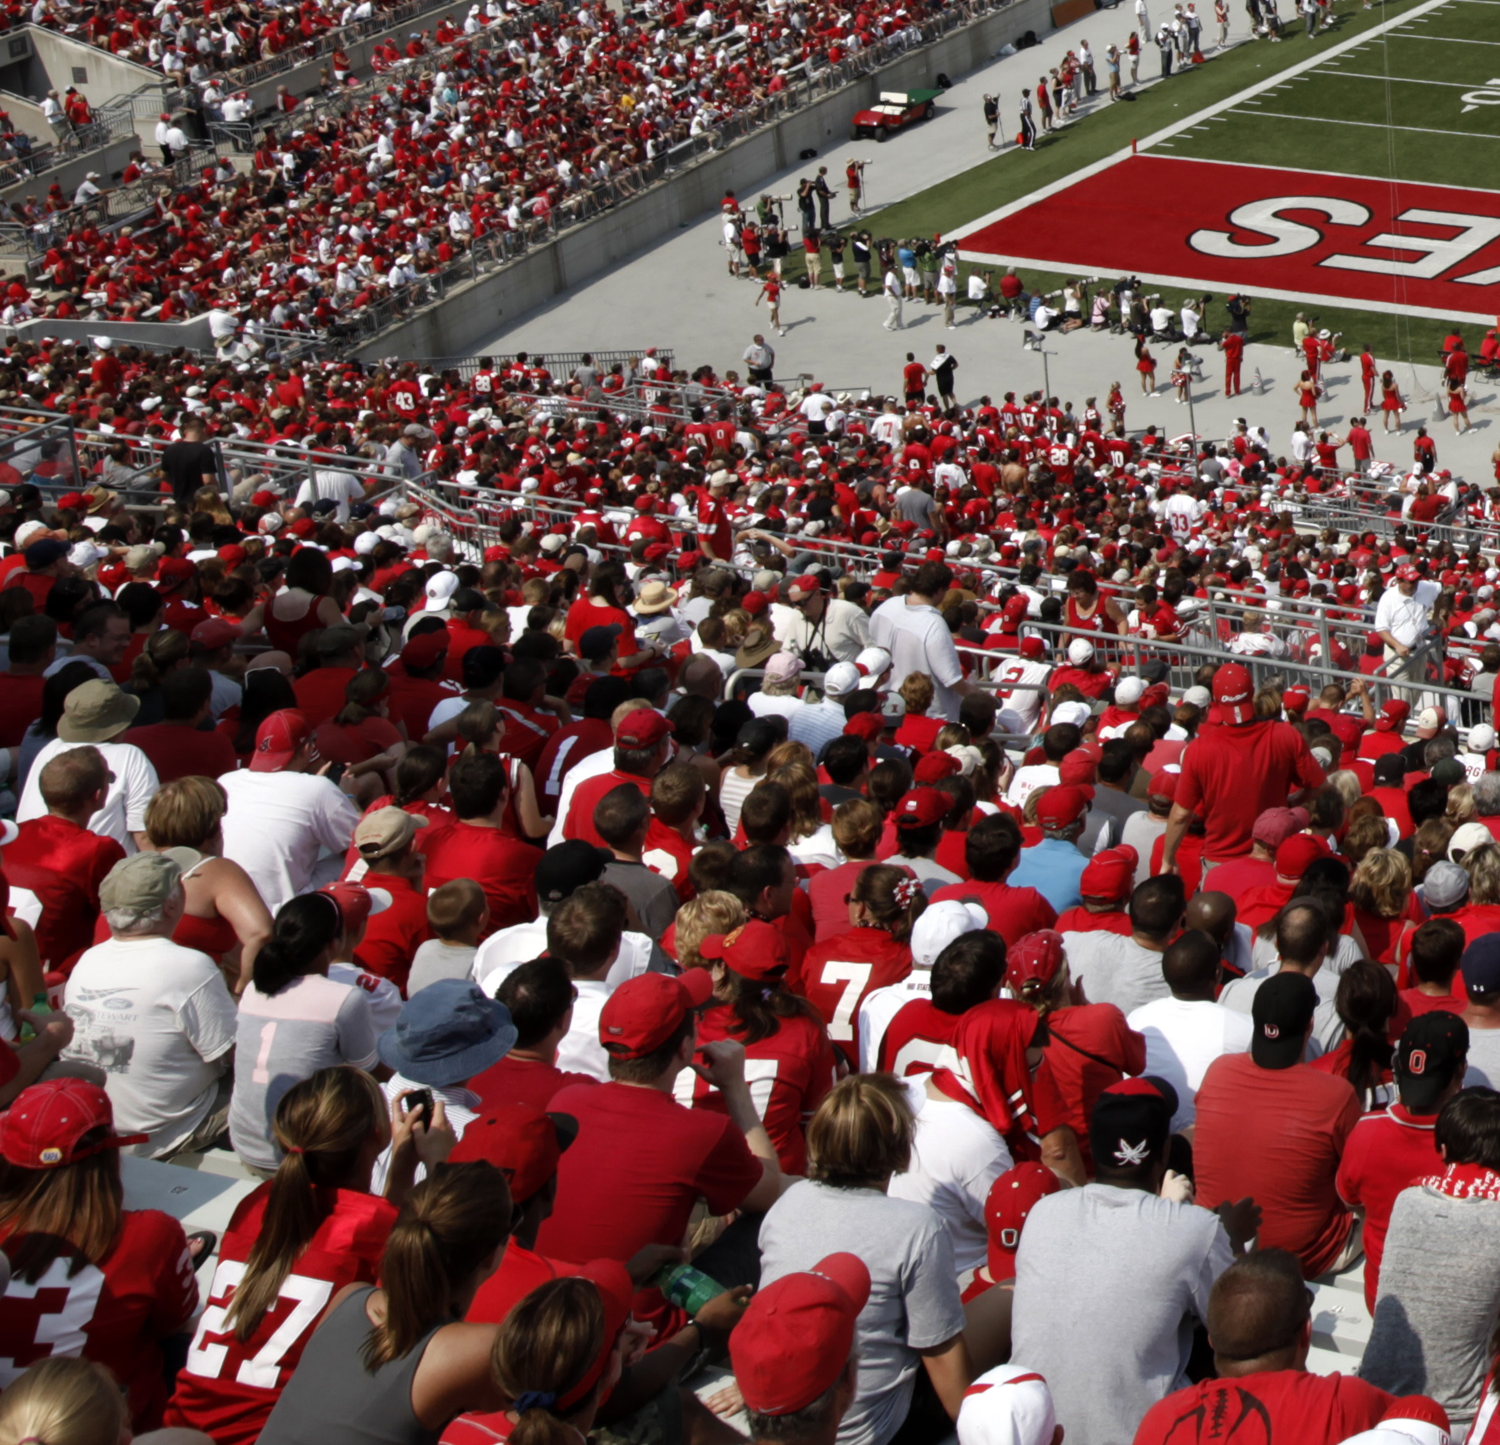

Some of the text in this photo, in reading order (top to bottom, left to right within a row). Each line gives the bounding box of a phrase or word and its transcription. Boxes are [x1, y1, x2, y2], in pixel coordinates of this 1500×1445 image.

[1110, 450, 1124, 468] 10
[1171, 513, 1189, 532] 33
[820, 960, 872, 1042] 7
[252, 1021, 278, 1085] 1
[1408, 1049, 1427, 1075] O
[186, 1258, 335, 1390] 27
